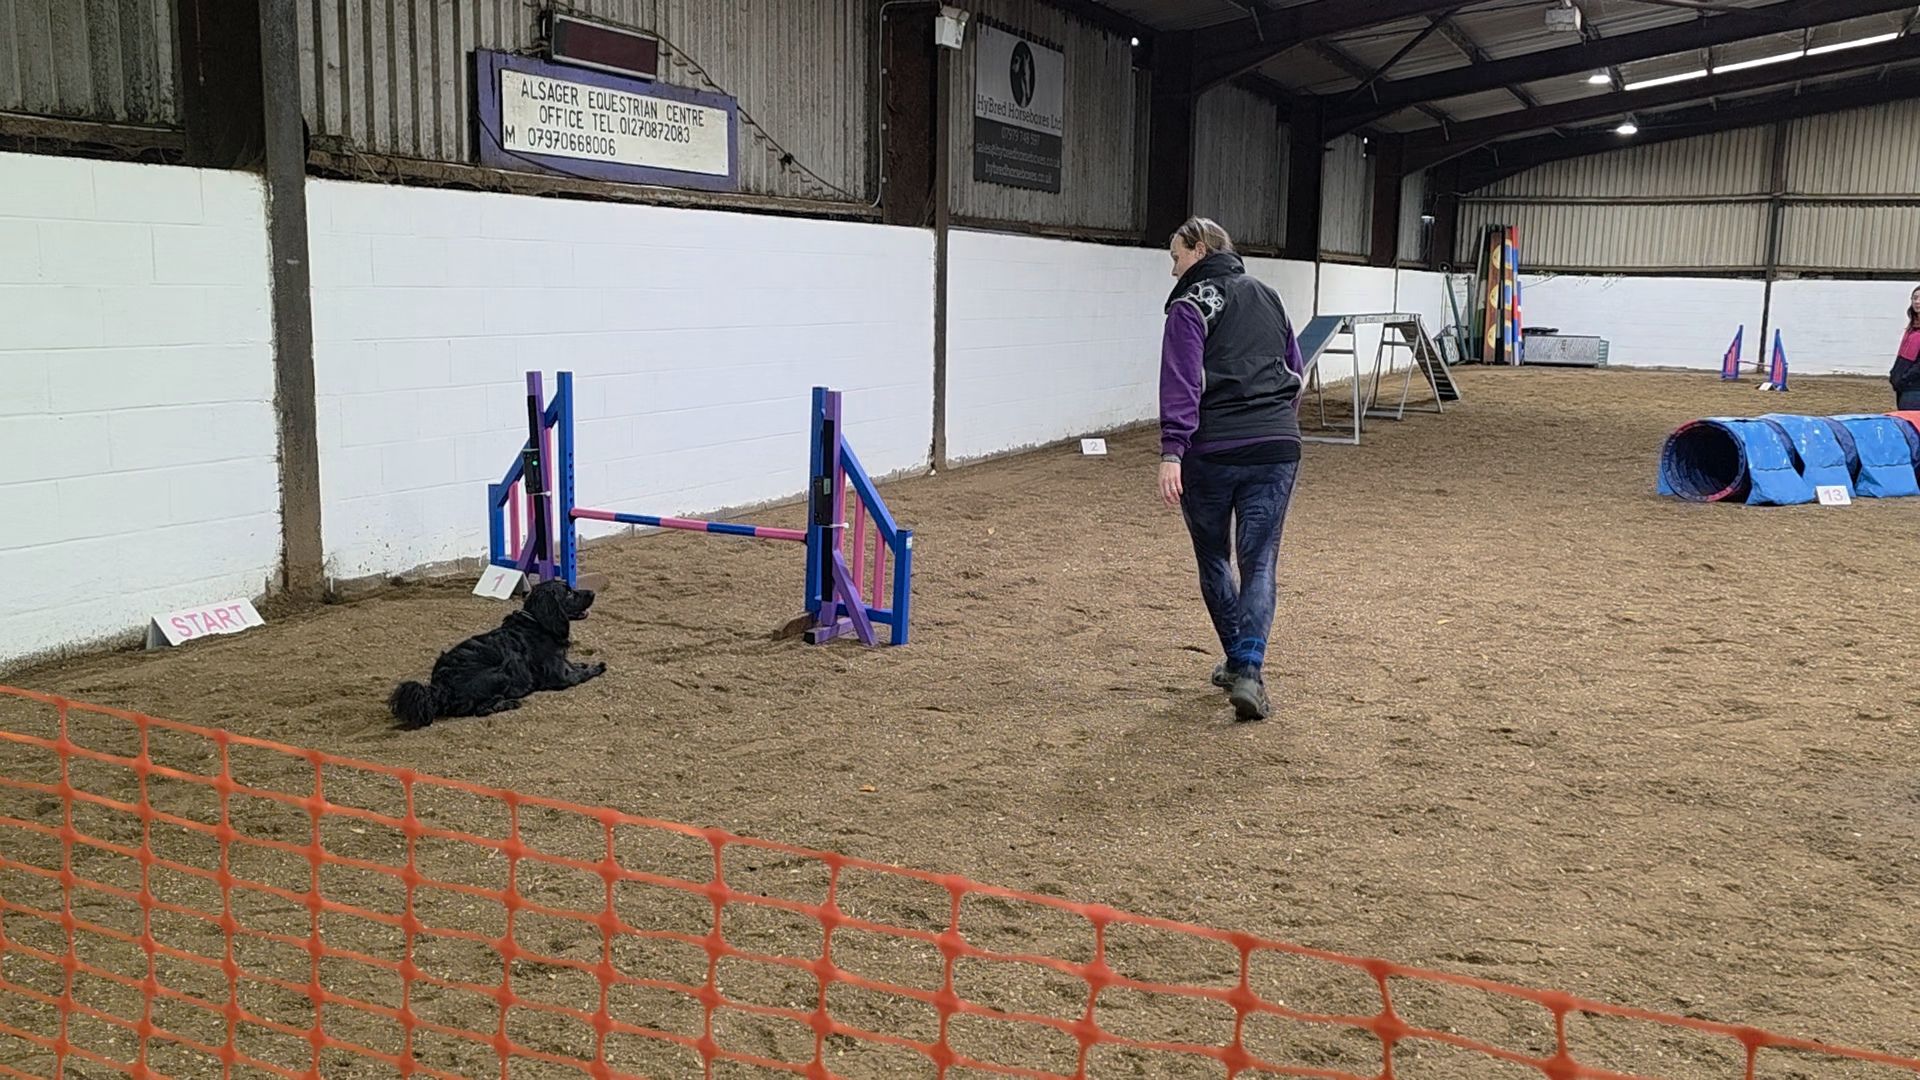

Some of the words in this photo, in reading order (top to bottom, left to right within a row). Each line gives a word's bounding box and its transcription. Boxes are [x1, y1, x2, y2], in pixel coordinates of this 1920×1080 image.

[520, 78, 579, 106] ALSAGER
[588, 90, 658, 120] EQUESTRIAN
[666, 104, 705, 128] CENTRE
[977, 94, 1007, 115] HyBred
[539, 104, 584, 130] OFFICE
[505, 125, 516, 145] M
[527, 127, 616, 156] 07970668006
[1090, 441, 1100, 451] 2
[1823, 489, 1843, 501] 13
[492, 573, 505, 592] 1
[171, 605, 247, 637] START
